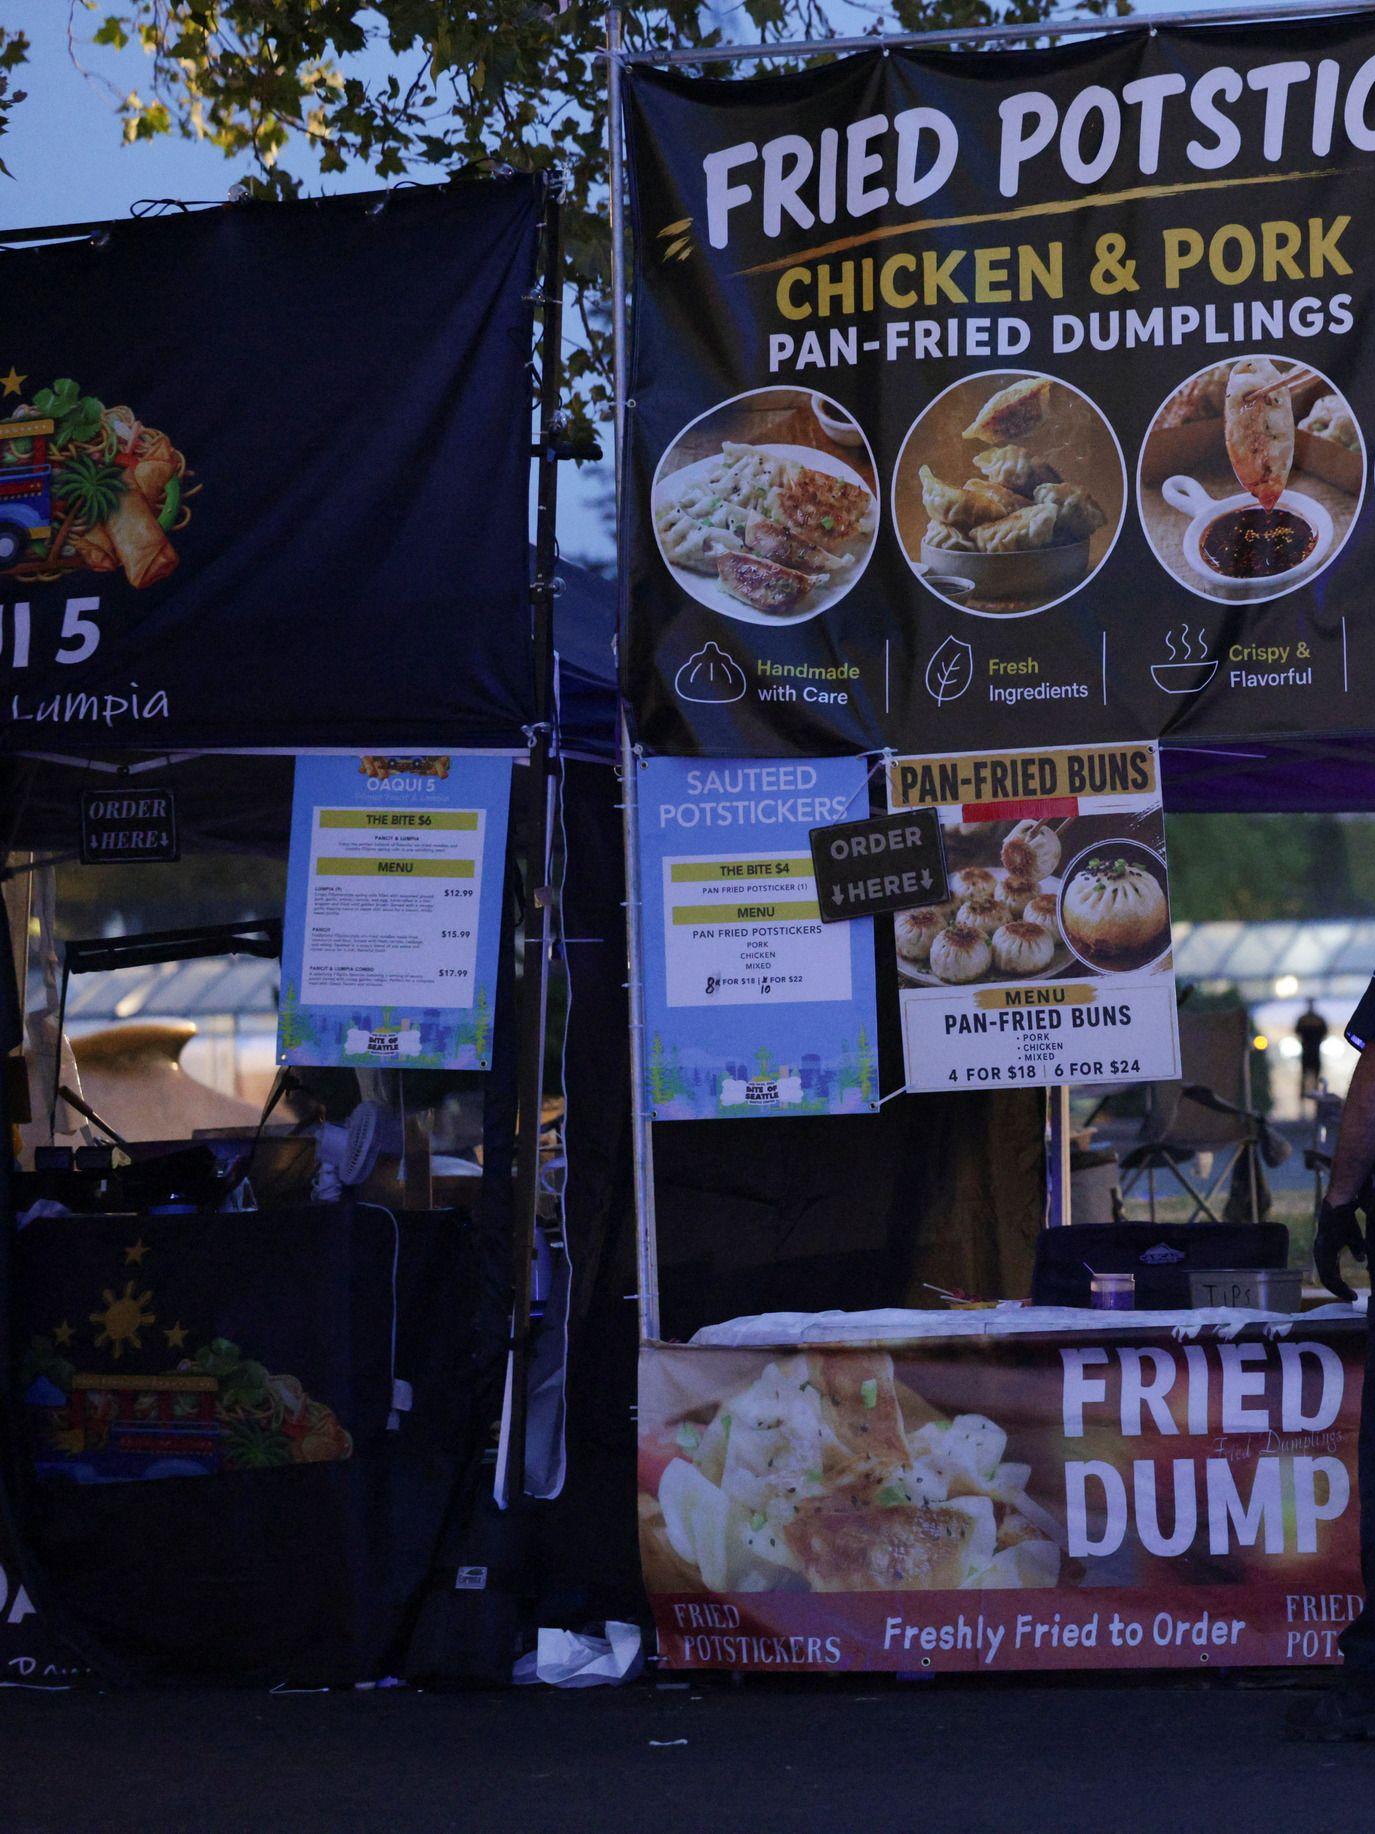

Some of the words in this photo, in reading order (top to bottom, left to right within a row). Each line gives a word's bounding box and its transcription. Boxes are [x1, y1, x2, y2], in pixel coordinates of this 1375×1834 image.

[703, 106, 959, 249] FRIED
[776, 242, 1063, 320] CHICKEN
[1090, 233, 1140, 293] &
[1163, 215, 1354, 291] PORK
[769, 316, 1032, 373] PAN-FRIED
[1051, 293, 1355, 353] DUMPLINGS
[54, 596, 101, 664] 5
[1228, 644, 1291, 665] Crispy
[1296, 642, 1311, 659] &
[757, 659, 860, 680] Handmade
[988, 658, 1040, 675] Fresh
[1230, 668, 1313, 689] Flavorful
[758, 686, 797, 703] with
[803, 686, 849, 705] Care
[989, 681, 1089, 706] Ingredients
[12, 681, 170, 727] Lumpia
[367, 778, 422, 792] OAQUI
[426, 779, 435, 792] 5
[687, 766, 817, 796] SAUTEED
[901, 759, 1058, 803] PAN-FRIED
[1067, 751, 1150, 794] BUNS
[89, 800, 166, 820] ORDER
[366, 814, 388, 825] THE
[391, 815, 415, 826] BITE
[418, 815, 432, 826] $6
[660, 796, 848, 828] POTSTICKERS
[101, 830, 159, 850] HERE
[830, 826, 923, 860] ORDER
[377, 862, 414, 873] MENU
[720, 865, 743, 877] THE
[747, 864, 771, 876] BITE
[775, 862, 790, 875] $4
[444, 889, 473, 897] $12.99
[702, 887, 719, 895] PAN
[721, 885, 745, 893] FRIED
[747, 884, 795, 893] POTSTICKER
[797, 883, 808, 892] (1)
[848, 875, 919, 903] HERE
[737, 907, 775, 918] MENU
[441, 930, 470, 939] $15.99
[692, 929, 715, 940] PAN
[718, 928, 749, 938] FRIED
[751, 925, 822, 937] POTSTICKERS
[746, 941, 769, 949] PORK
[740, 951, 776, 960] CHICKEN
[439, 969, 468, 978] $17.99
[745, 962, 772, 970] MIXED
[705, 976, 715, 994] 8
[722, 978, 739, 986] FOR
[788, 975, 803, 983] $22
[1005, 988, 1065, 1006] MENU
[944, 1008, 1062, 1035] PAN-FRIED
[1072, 1005, 1132, 1028] BUNS
[1023, 1033, 1050, 1042] PORK
[1023, 1042, 1064, 1052] CHICKEN
[1024, 1052, 1055, 1061] MIXED
[949, 1069, 958, 1082] 4
[966, 1067, 1001, 1081] FOR
[1007, 1065, 1037, 1080] $18
[1054, 1063, 1064, 1077] 6
[1070, 1062, 1103, 1076] FOR
[1110, 1059, 1141, 1075] $24
[1060, 1341, 1345, 1438] FRIED
[672, 1603, 741, 1629] FRIED
[1286, 1594, 1364, 1624] FRIED
[884, 1614, 1005, 1664] Freshly
[1014, 1613, 1098, 1650] Fried
[1108, 1613, 1142, 1647] to
[1153, 1610, 1246, 1647] Order
[683, 1635, 841, 1664] POTSTICKERS
